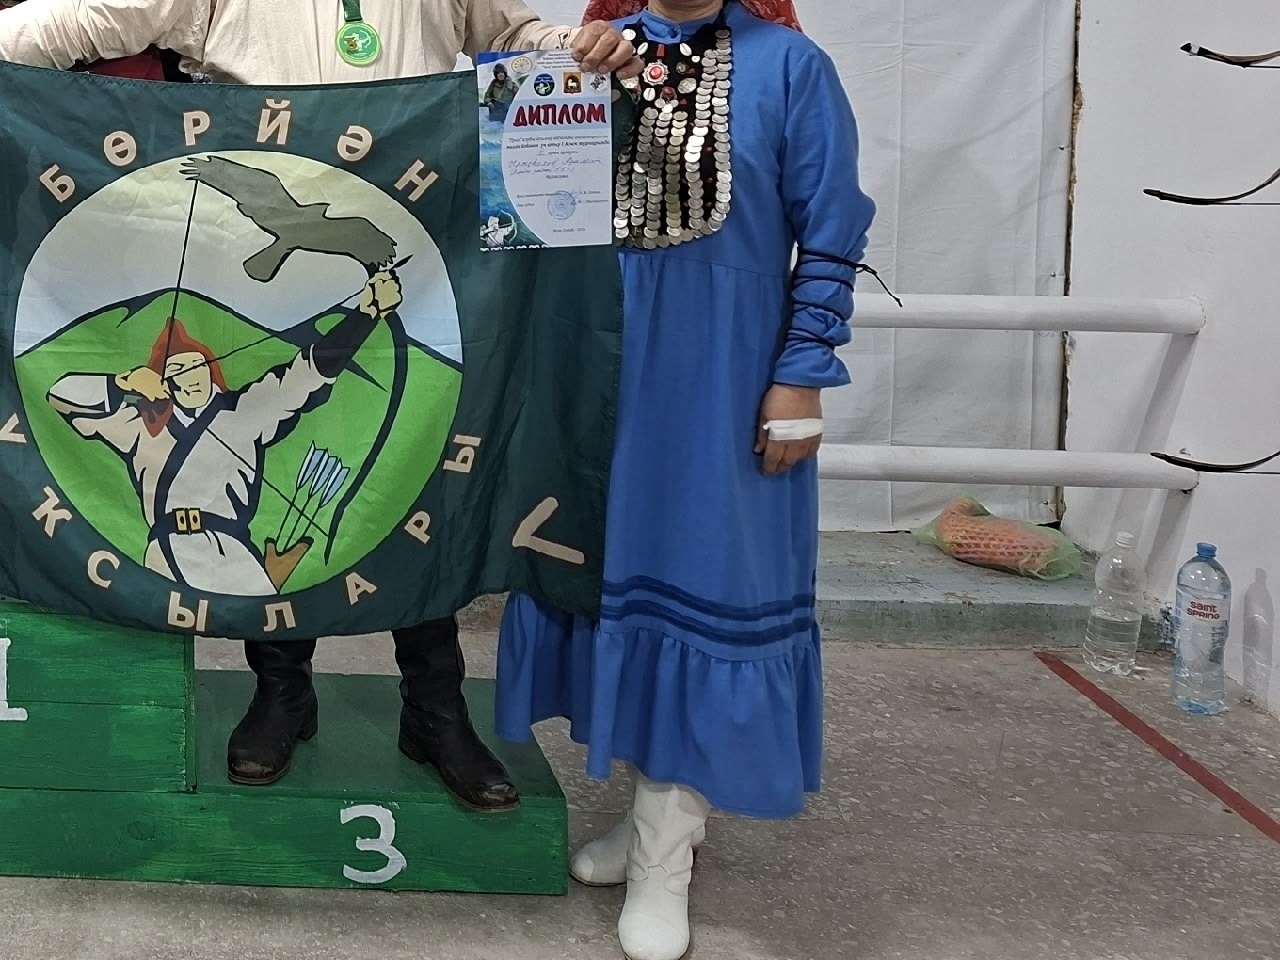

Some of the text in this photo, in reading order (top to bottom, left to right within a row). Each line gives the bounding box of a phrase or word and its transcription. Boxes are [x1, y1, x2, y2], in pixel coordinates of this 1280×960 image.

[39, 98, 439, 203] БӨРЙӘН
[513, 103, 607, 126] ДИПЛОМ
[340, 804, 408, 884] 3
